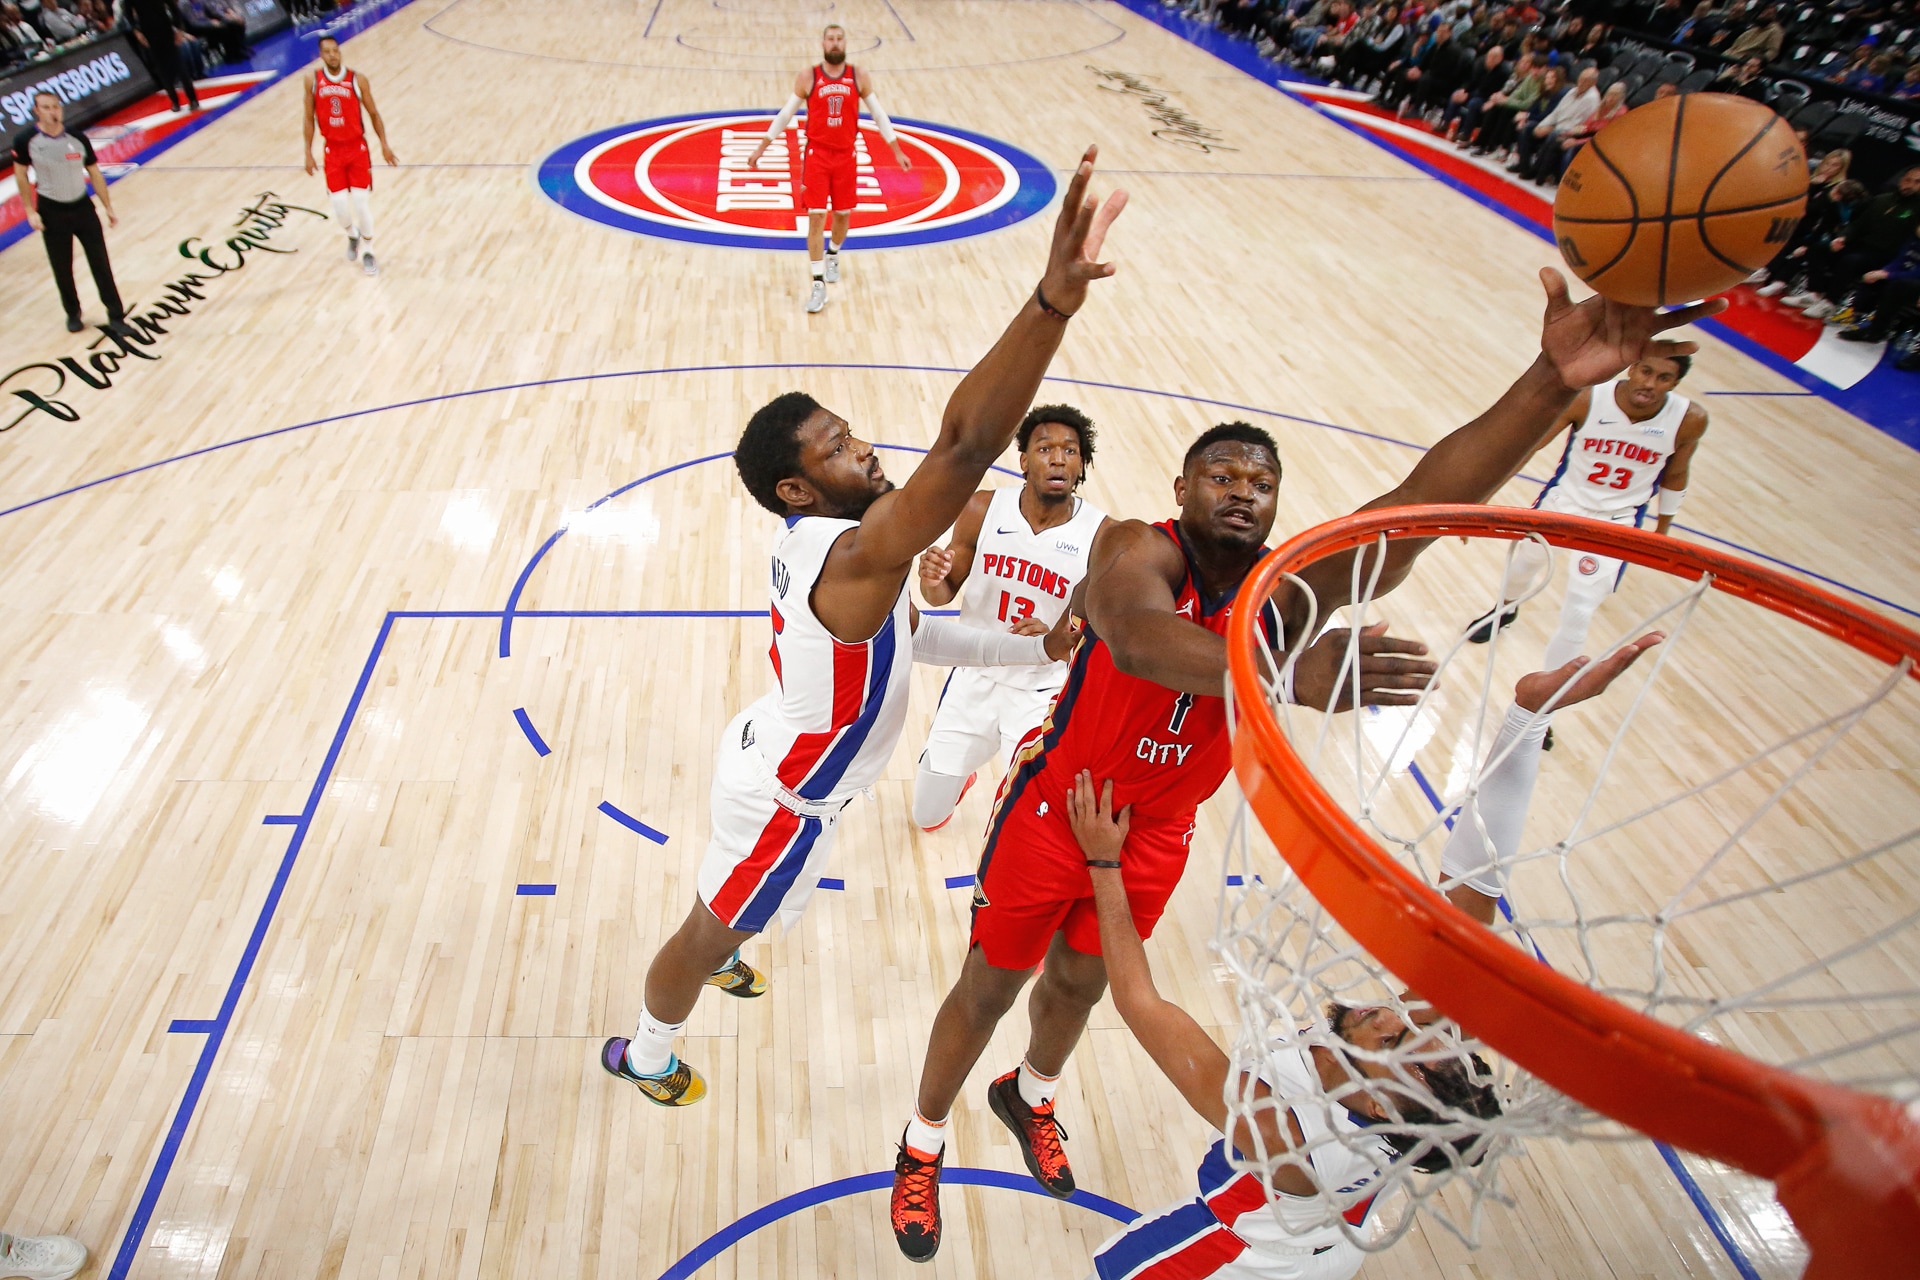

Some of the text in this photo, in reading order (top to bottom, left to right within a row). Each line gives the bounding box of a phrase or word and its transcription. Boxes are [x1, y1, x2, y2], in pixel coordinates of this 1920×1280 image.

[330, 97, 342, 116] 3
[828, 95, 844, 115] 17
[716, 129, 794, 212] DETROIT
[178, 191, 328, 277] Equity
[1583, 438, 1662, 465] PISTONS
[1587, 462, 1633, 490] 23
[1055, 540, 1079, 555] UWM
[983, 553, 1070, 599] PISTONS
[997, 590, 1035, 624] 13
[1136, 737, 1193, 766] CITY
